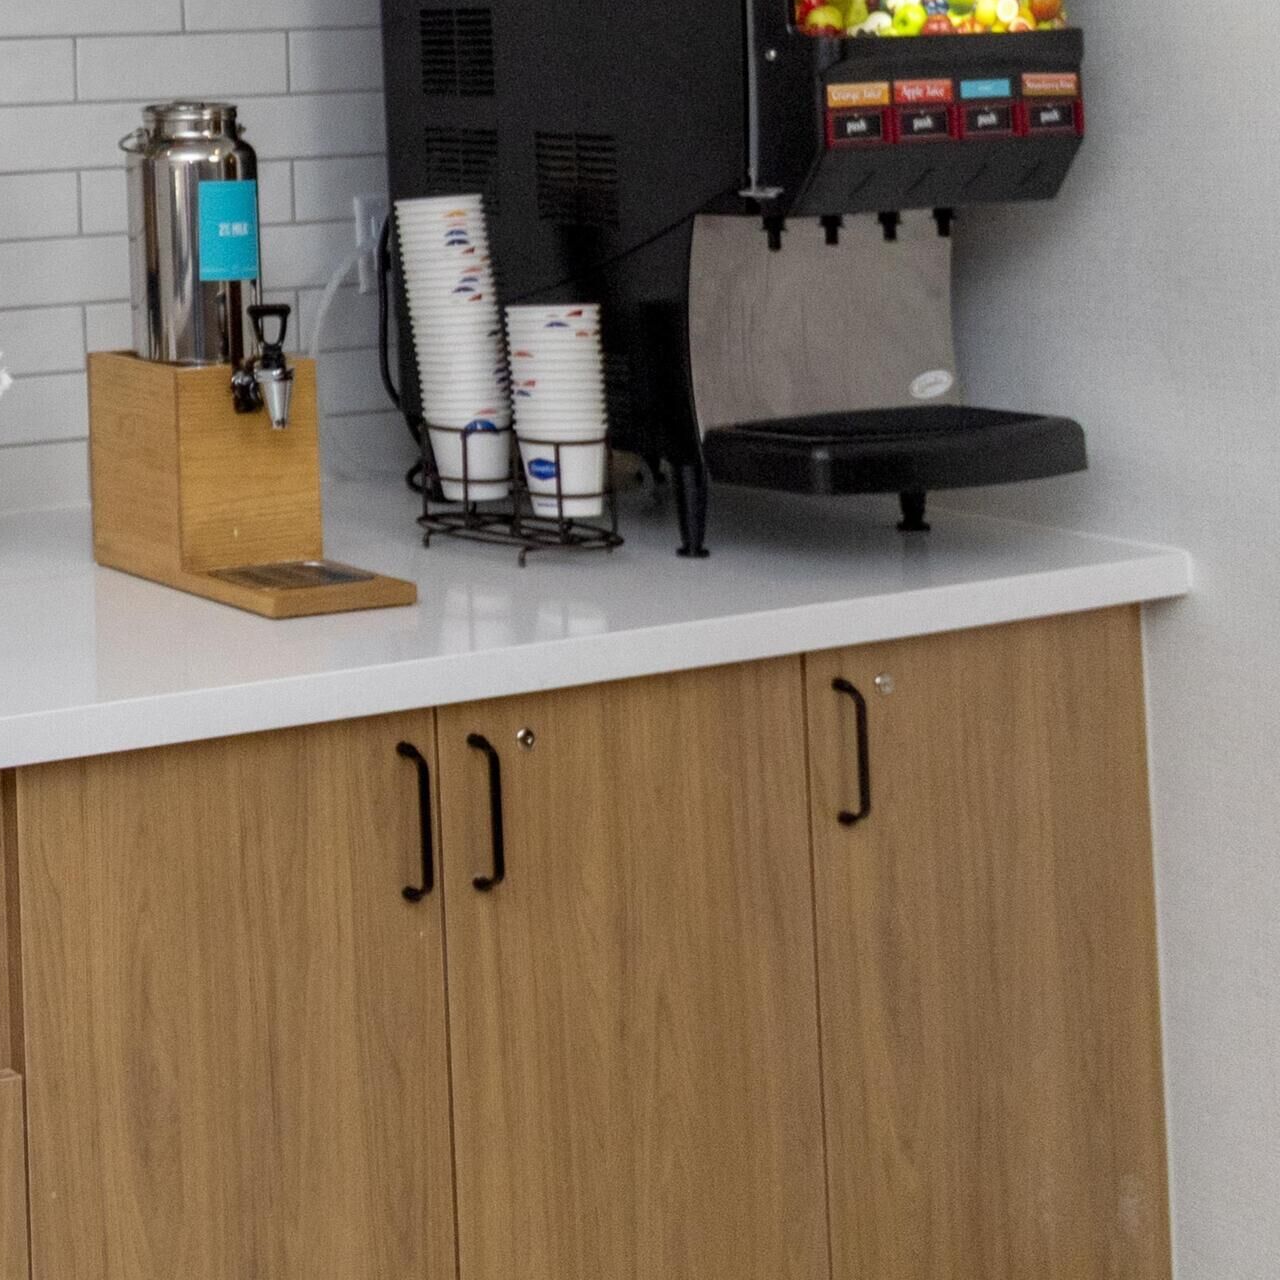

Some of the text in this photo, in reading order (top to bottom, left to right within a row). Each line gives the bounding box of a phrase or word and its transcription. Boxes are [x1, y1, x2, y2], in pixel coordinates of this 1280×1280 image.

[846, 118, 867, 135] push
[912, 115, 933, 131] push
[977, 112, 997, 128] push
